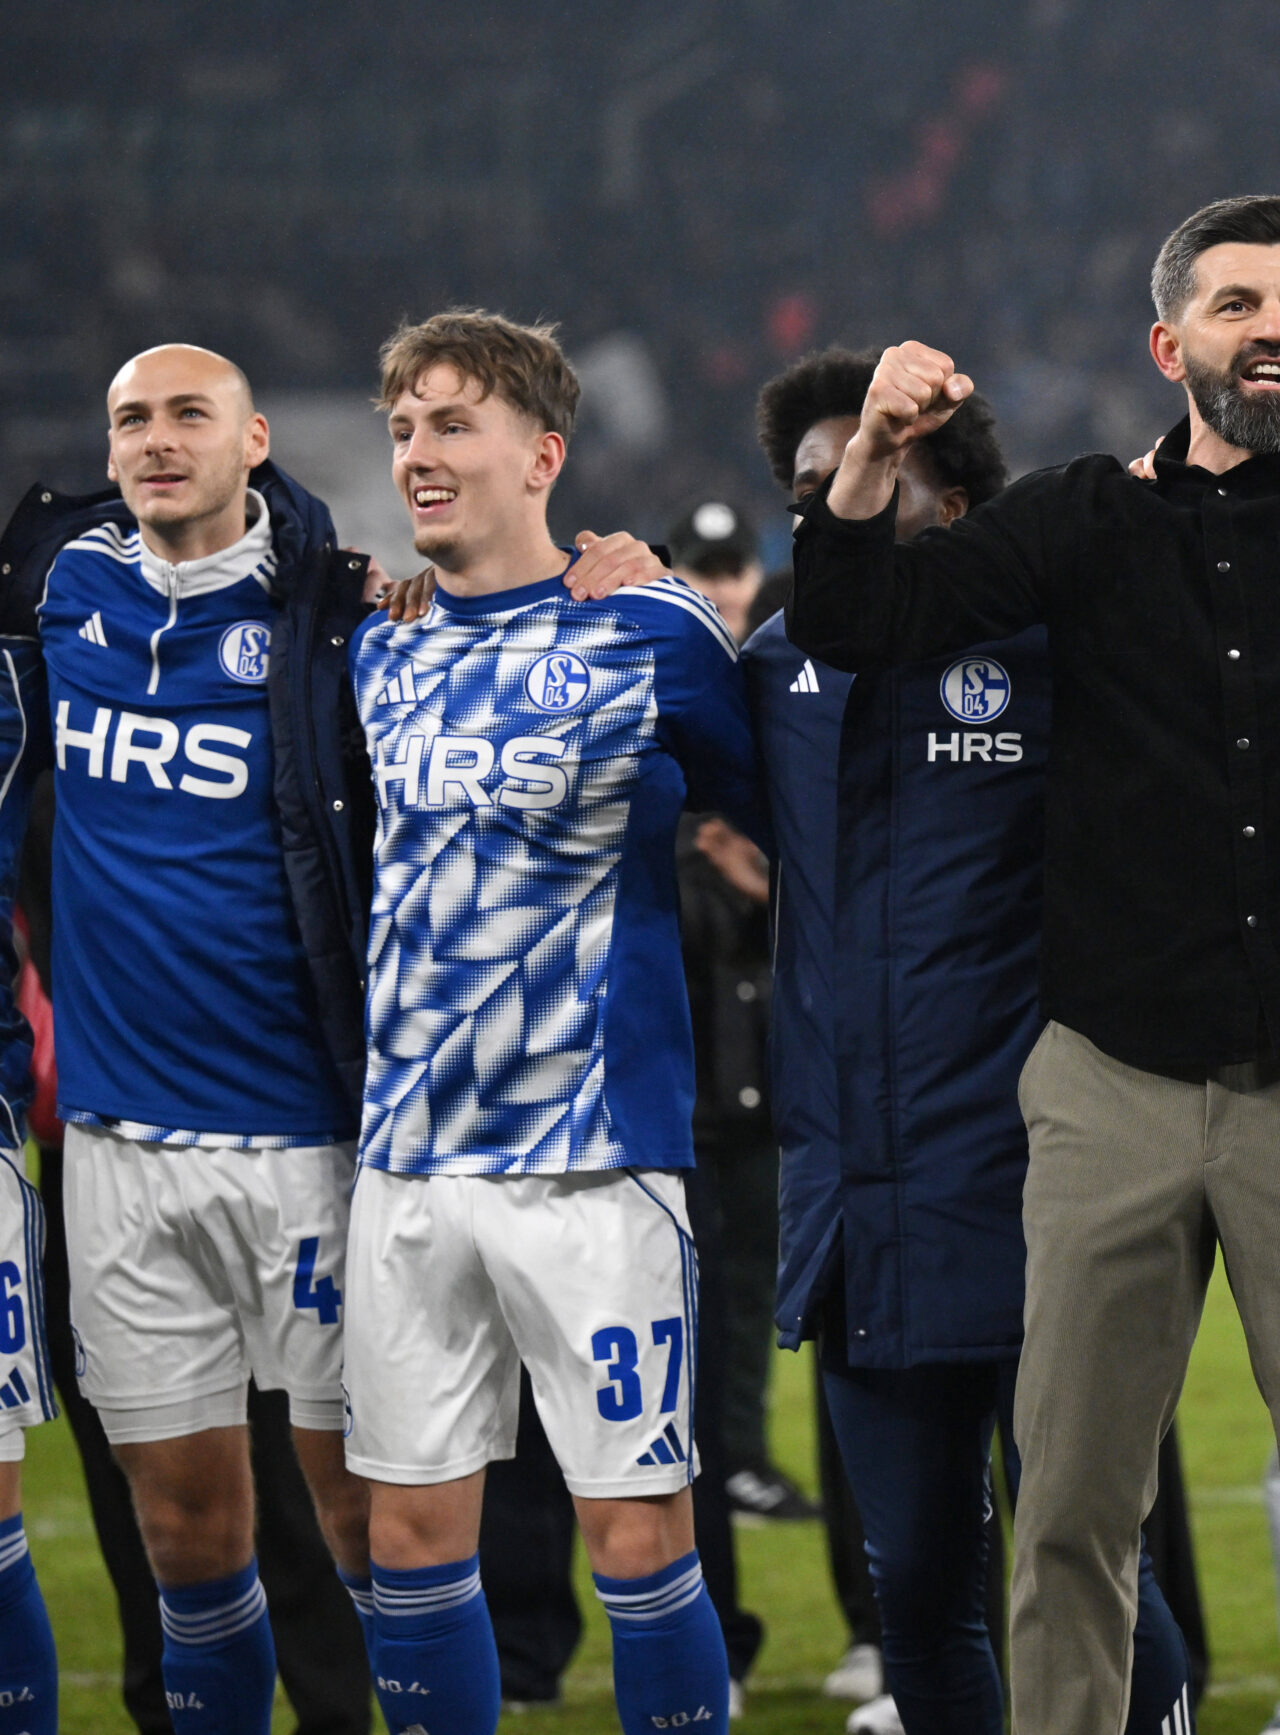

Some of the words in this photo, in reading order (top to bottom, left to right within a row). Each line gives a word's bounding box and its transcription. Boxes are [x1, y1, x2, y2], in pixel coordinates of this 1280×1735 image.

[55, 700, 253, 799] HRS
[375, 735, 569, 810] HRS
[927, 732, 1024, 763] HRS
[0, 1260, 27, 1355] 6
[293, 1236, 342, 1325] 4
[590, 1315, 684, 1422] 37
